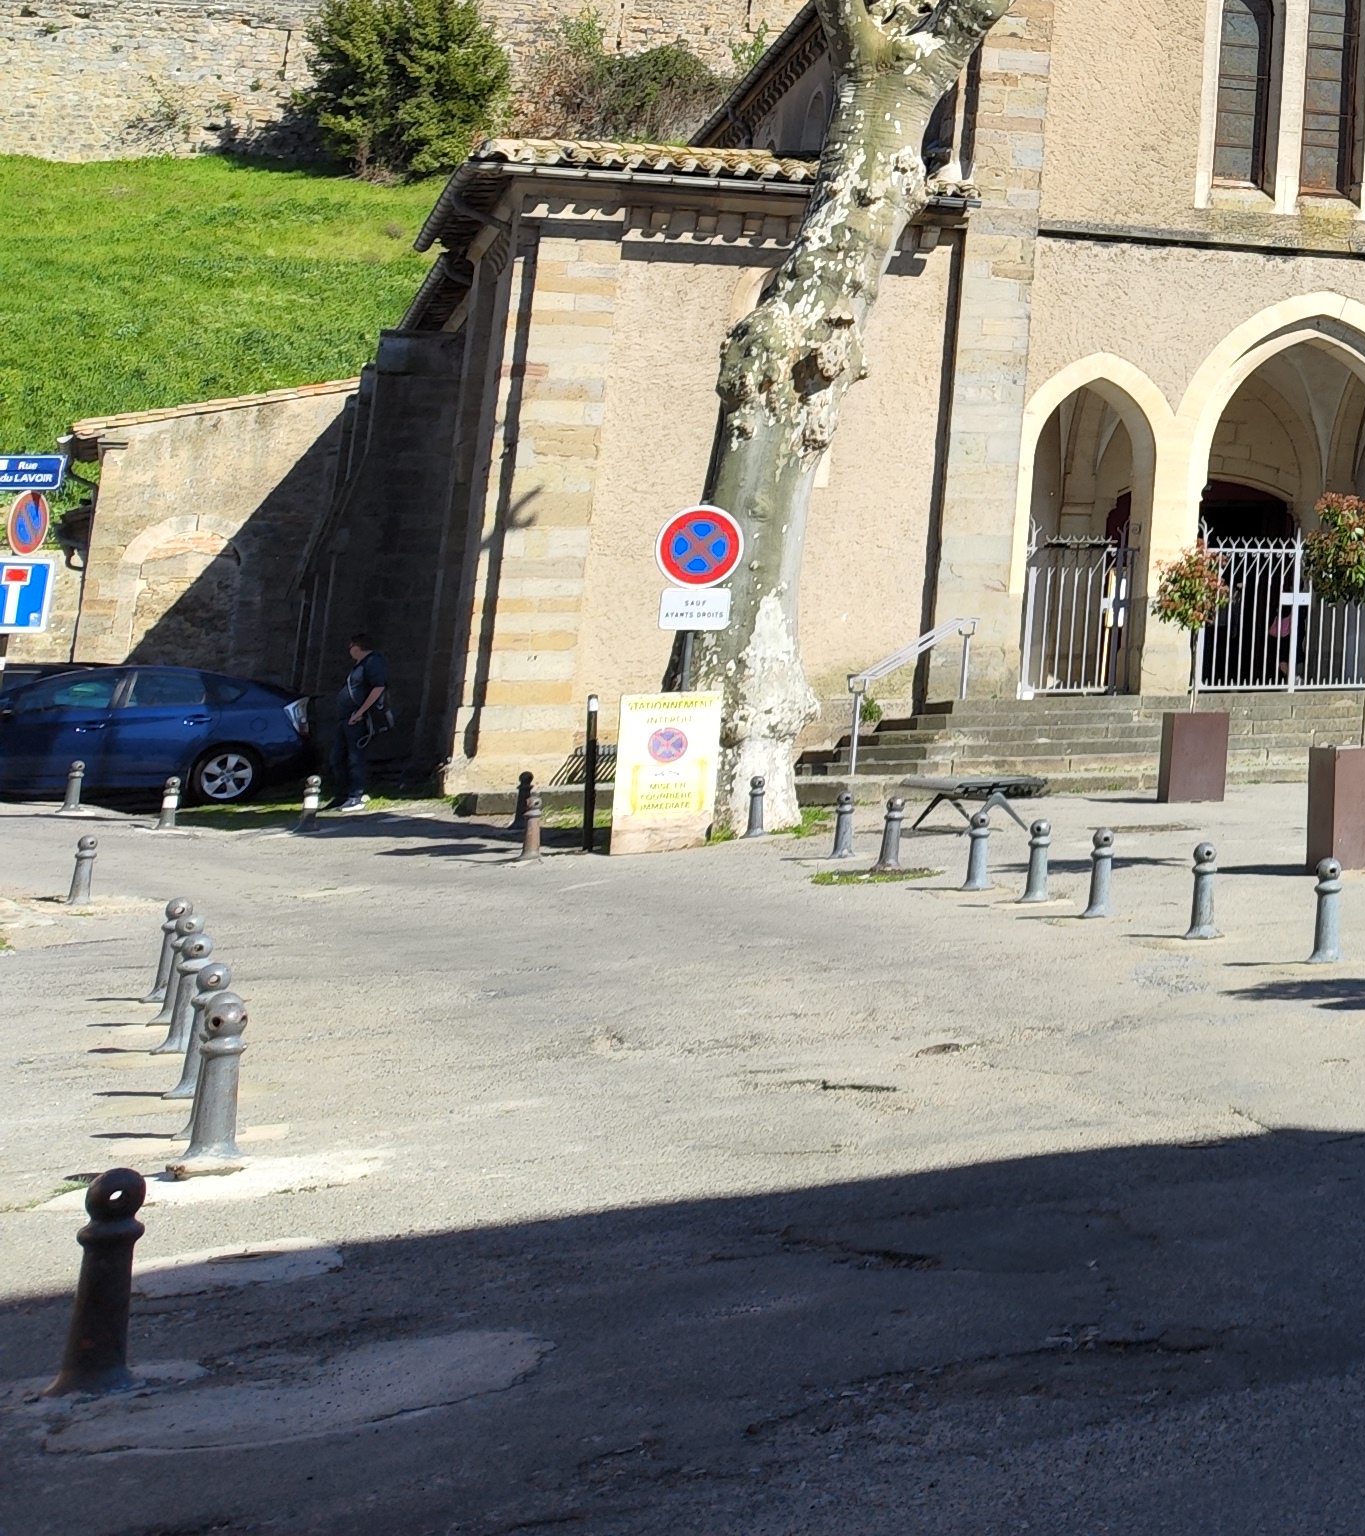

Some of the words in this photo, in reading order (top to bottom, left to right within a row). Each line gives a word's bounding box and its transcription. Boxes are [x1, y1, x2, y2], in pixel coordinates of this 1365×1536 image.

[18, 461, 38, 470] Rue
[14, 473, 53, 483] LAVOIR
[696, 611, 724, 619] DROITS
[628, 700, 713, 710] STATIONNEMENT
